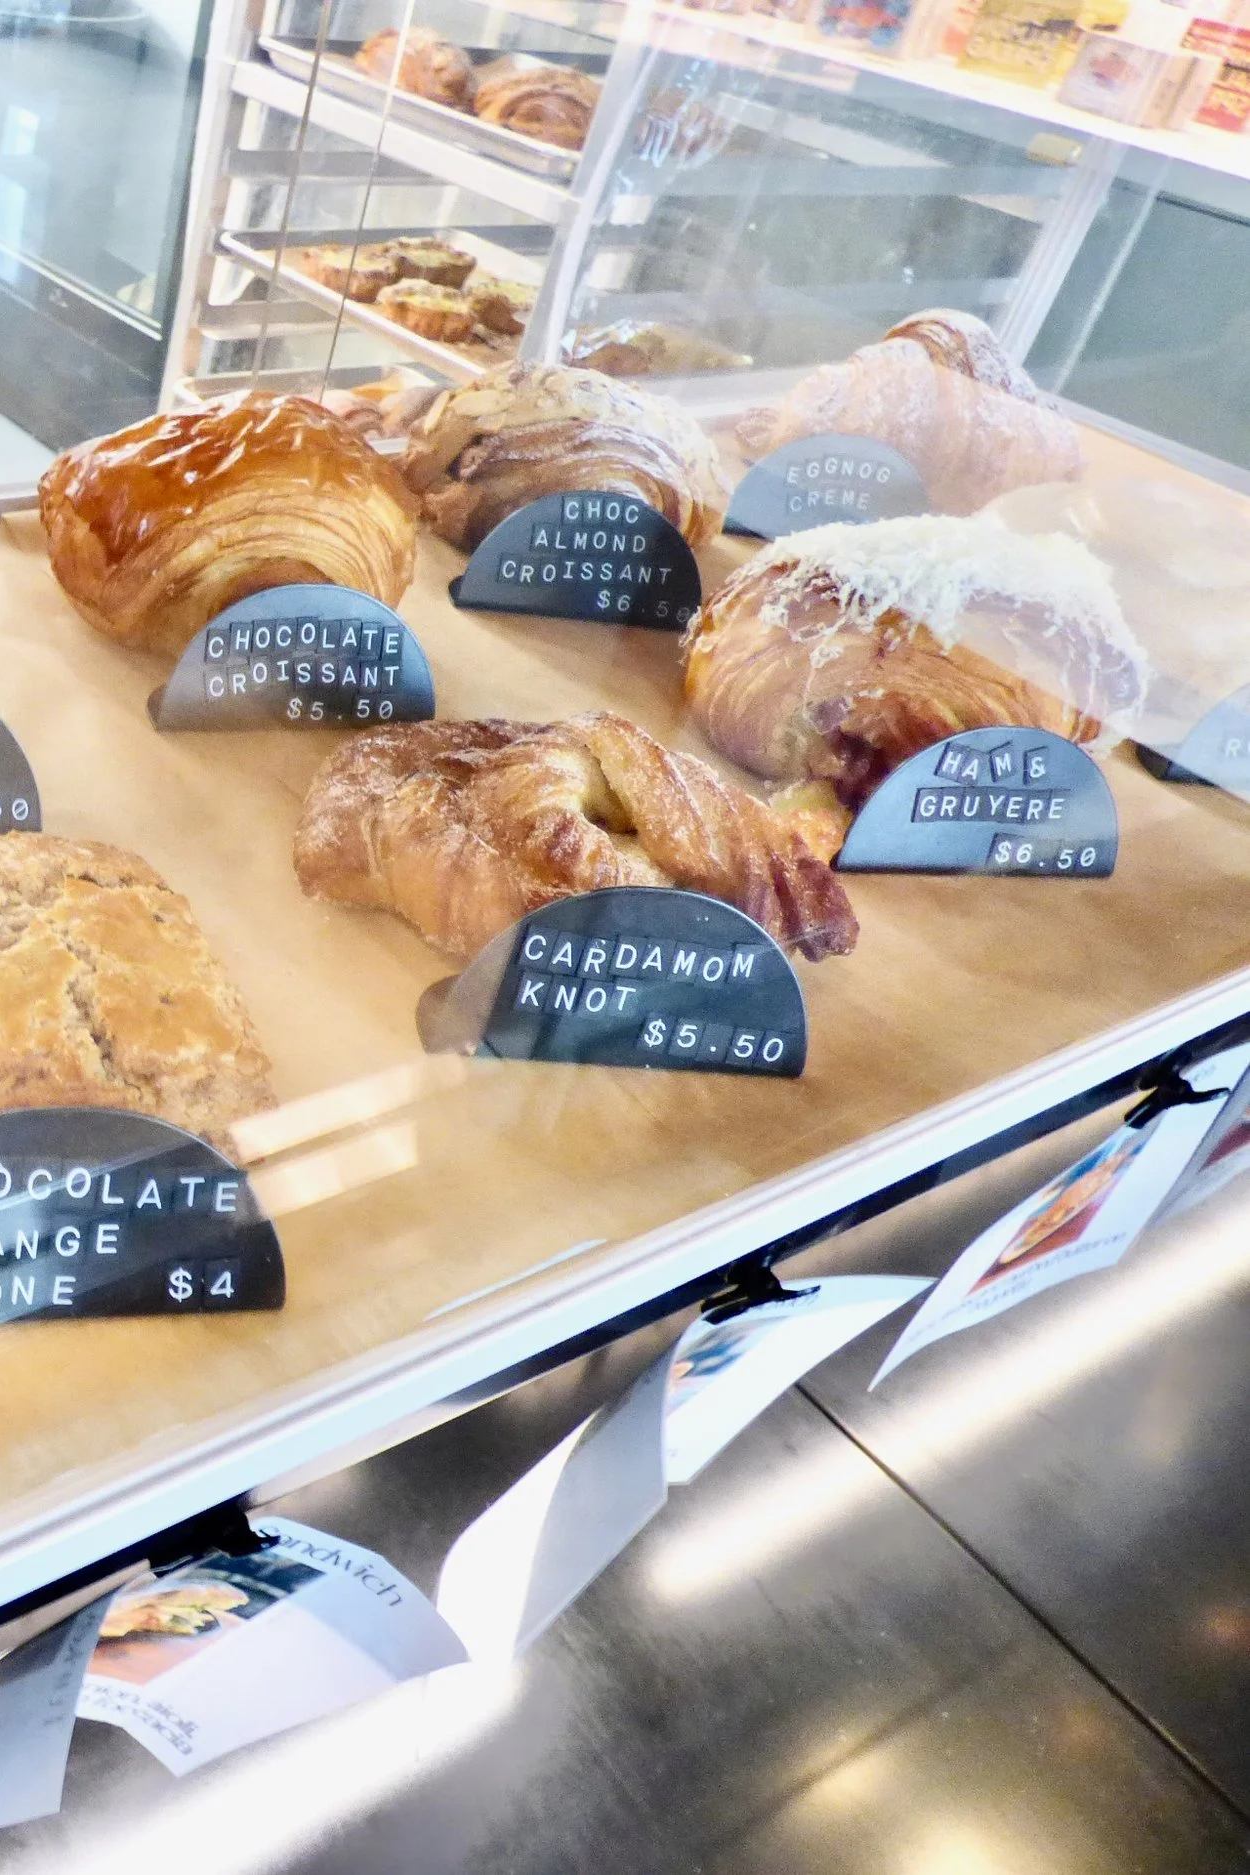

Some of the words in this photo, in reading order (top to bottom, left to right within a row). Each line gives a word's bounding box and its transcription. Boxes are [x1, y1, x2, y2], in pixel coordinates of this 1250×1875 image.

[787, 457, 891, 485] EGGNOG
[565, 501, 639, 524] CHOC
[789, 489, 871, 512] CREME
[534, 529, 646, 553] ALMOND
[502, 560, 672, 585] CROISSANT
[597, 590, 691, 622] $6.50
[208, 622, 400, 658] CHOCOLATE
[209, 660, 400, 697] CROISSANT
[287, 697, 394, 721] $5.50
[920, 795, 1065, 820] GRUYERE
[995, 841, 1096, 870] $6.50
[524, 934, 755, 983] CARDAMOM
[520, 980, 637, 1013] KNOT
[644, 1018, 784, 1062] $5.50
[168, 1266, 235, 1303] $4
